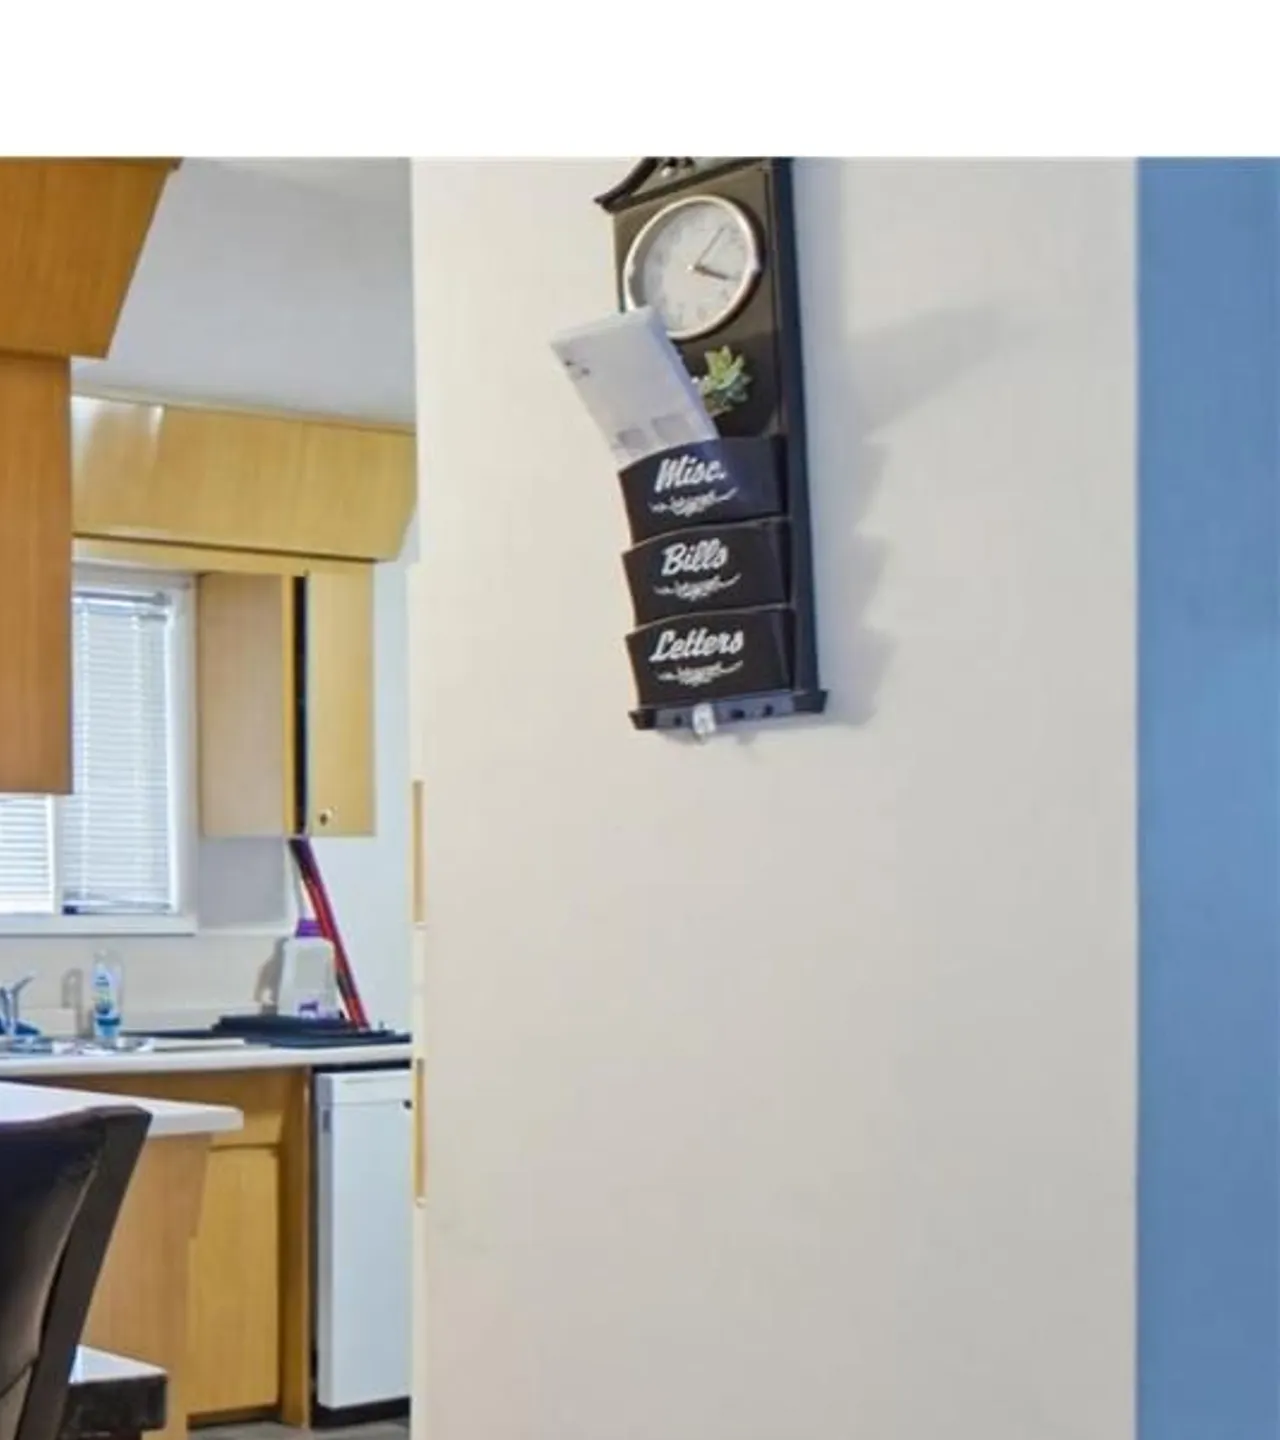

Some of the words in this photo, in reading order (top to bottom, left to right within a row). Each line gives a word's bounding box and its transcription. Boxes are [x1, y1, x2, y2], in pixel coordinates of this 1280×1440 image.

[654, 454, 727, 493] Misc.
[660, 538, 728, 576] Bills
[648, 627, 744, 662] Letters
